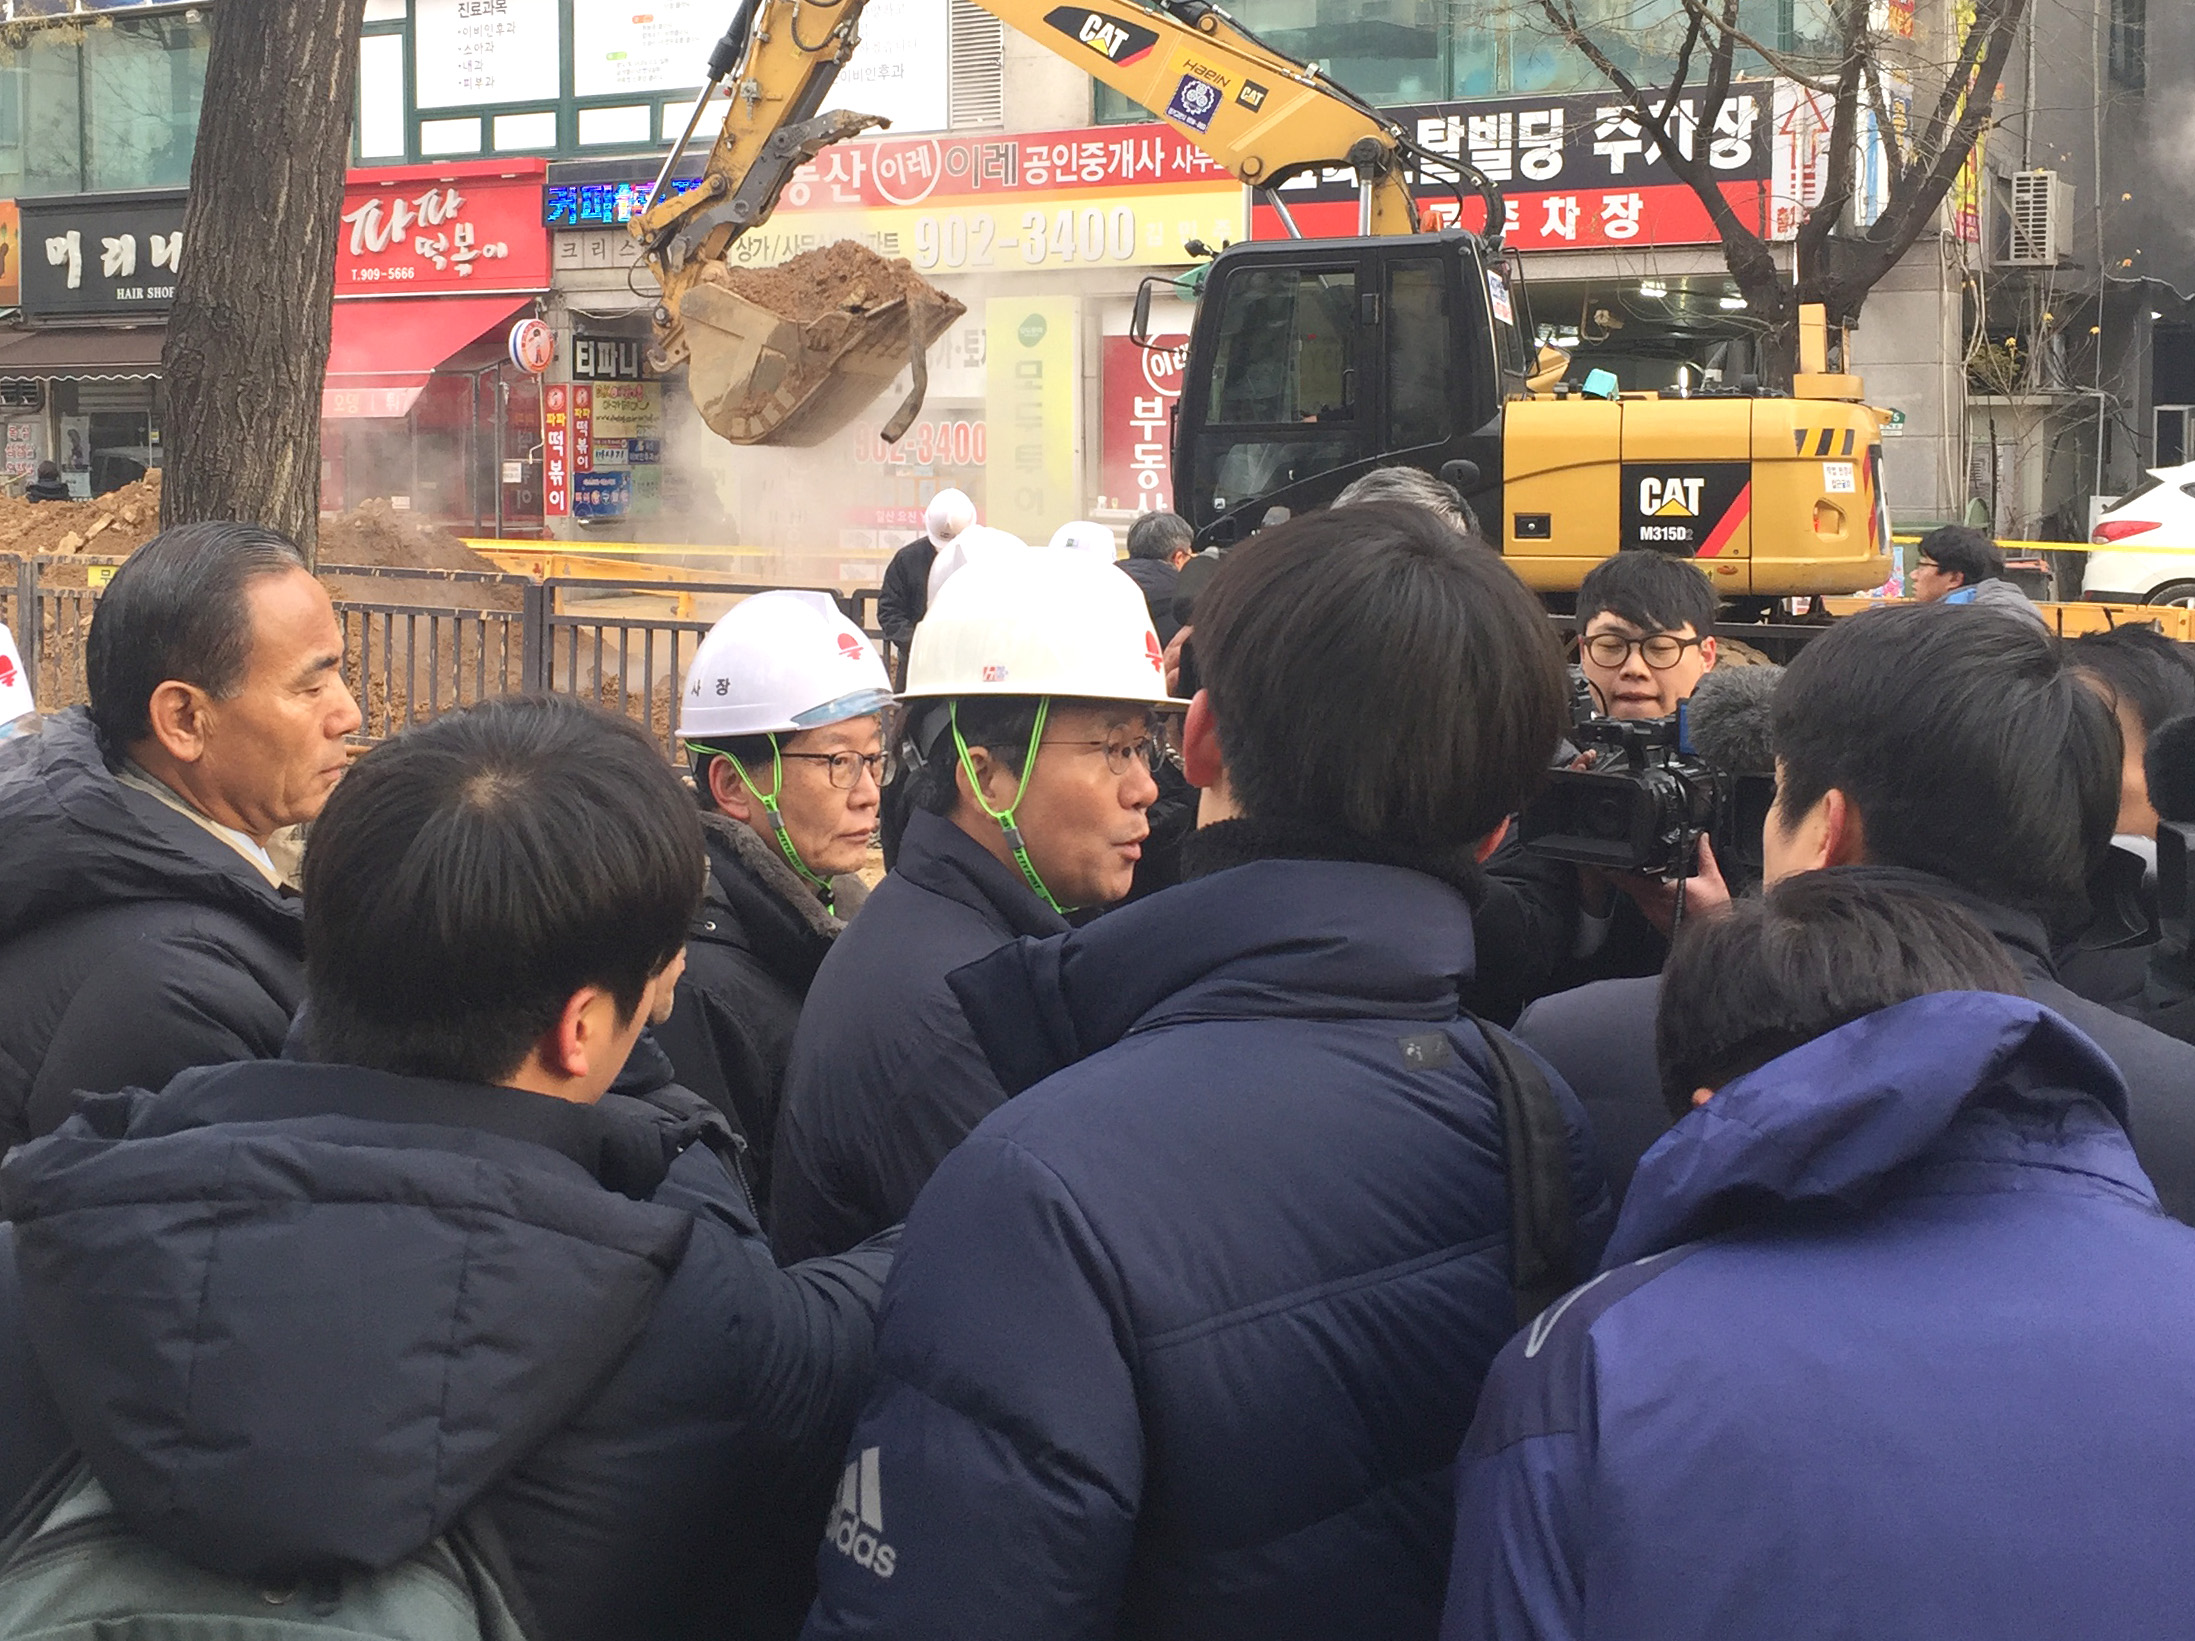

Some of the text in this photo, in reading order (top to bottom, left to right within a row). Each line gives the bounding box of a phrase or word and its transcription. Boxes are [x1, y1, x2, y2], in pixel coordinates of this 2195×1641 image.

[463, 21, 517, 37] 이비인후과
[1079, 14, 1130, 58] CAT
[463, 76, 495, 90] 피부과
[834, 63, 904, 84] 이비인후과
[1240, 86, 1264, 107] CAT
[880, 145, 933, 185] 이레
[945, 142, 1018, 189] 이레
[1023, 137, 1165, 185] 공인중개사
[1171, 144, 1226, 174] 사무
[1277, 95, 1758, 190] 탈빌딩 주차장
[414, 222, 509, 278] 떡볶이
[914, 205, 1136, 269] 902-3400
[116, 288, 144, 300] HAIR
[351, 267, 415, 280] T.909-5666
[576, 340, 639, 378] 티파니
[546, 412, 567, 427] 파파
[1015, 360, 1045, 516] 모두투어
[576, 420, 589, 469] 떡볶이
[547, 430, 565, 511] 떡볶이
[1639, 477, 1705, 516] CAT
[826, 1506, 897, 1578] das
